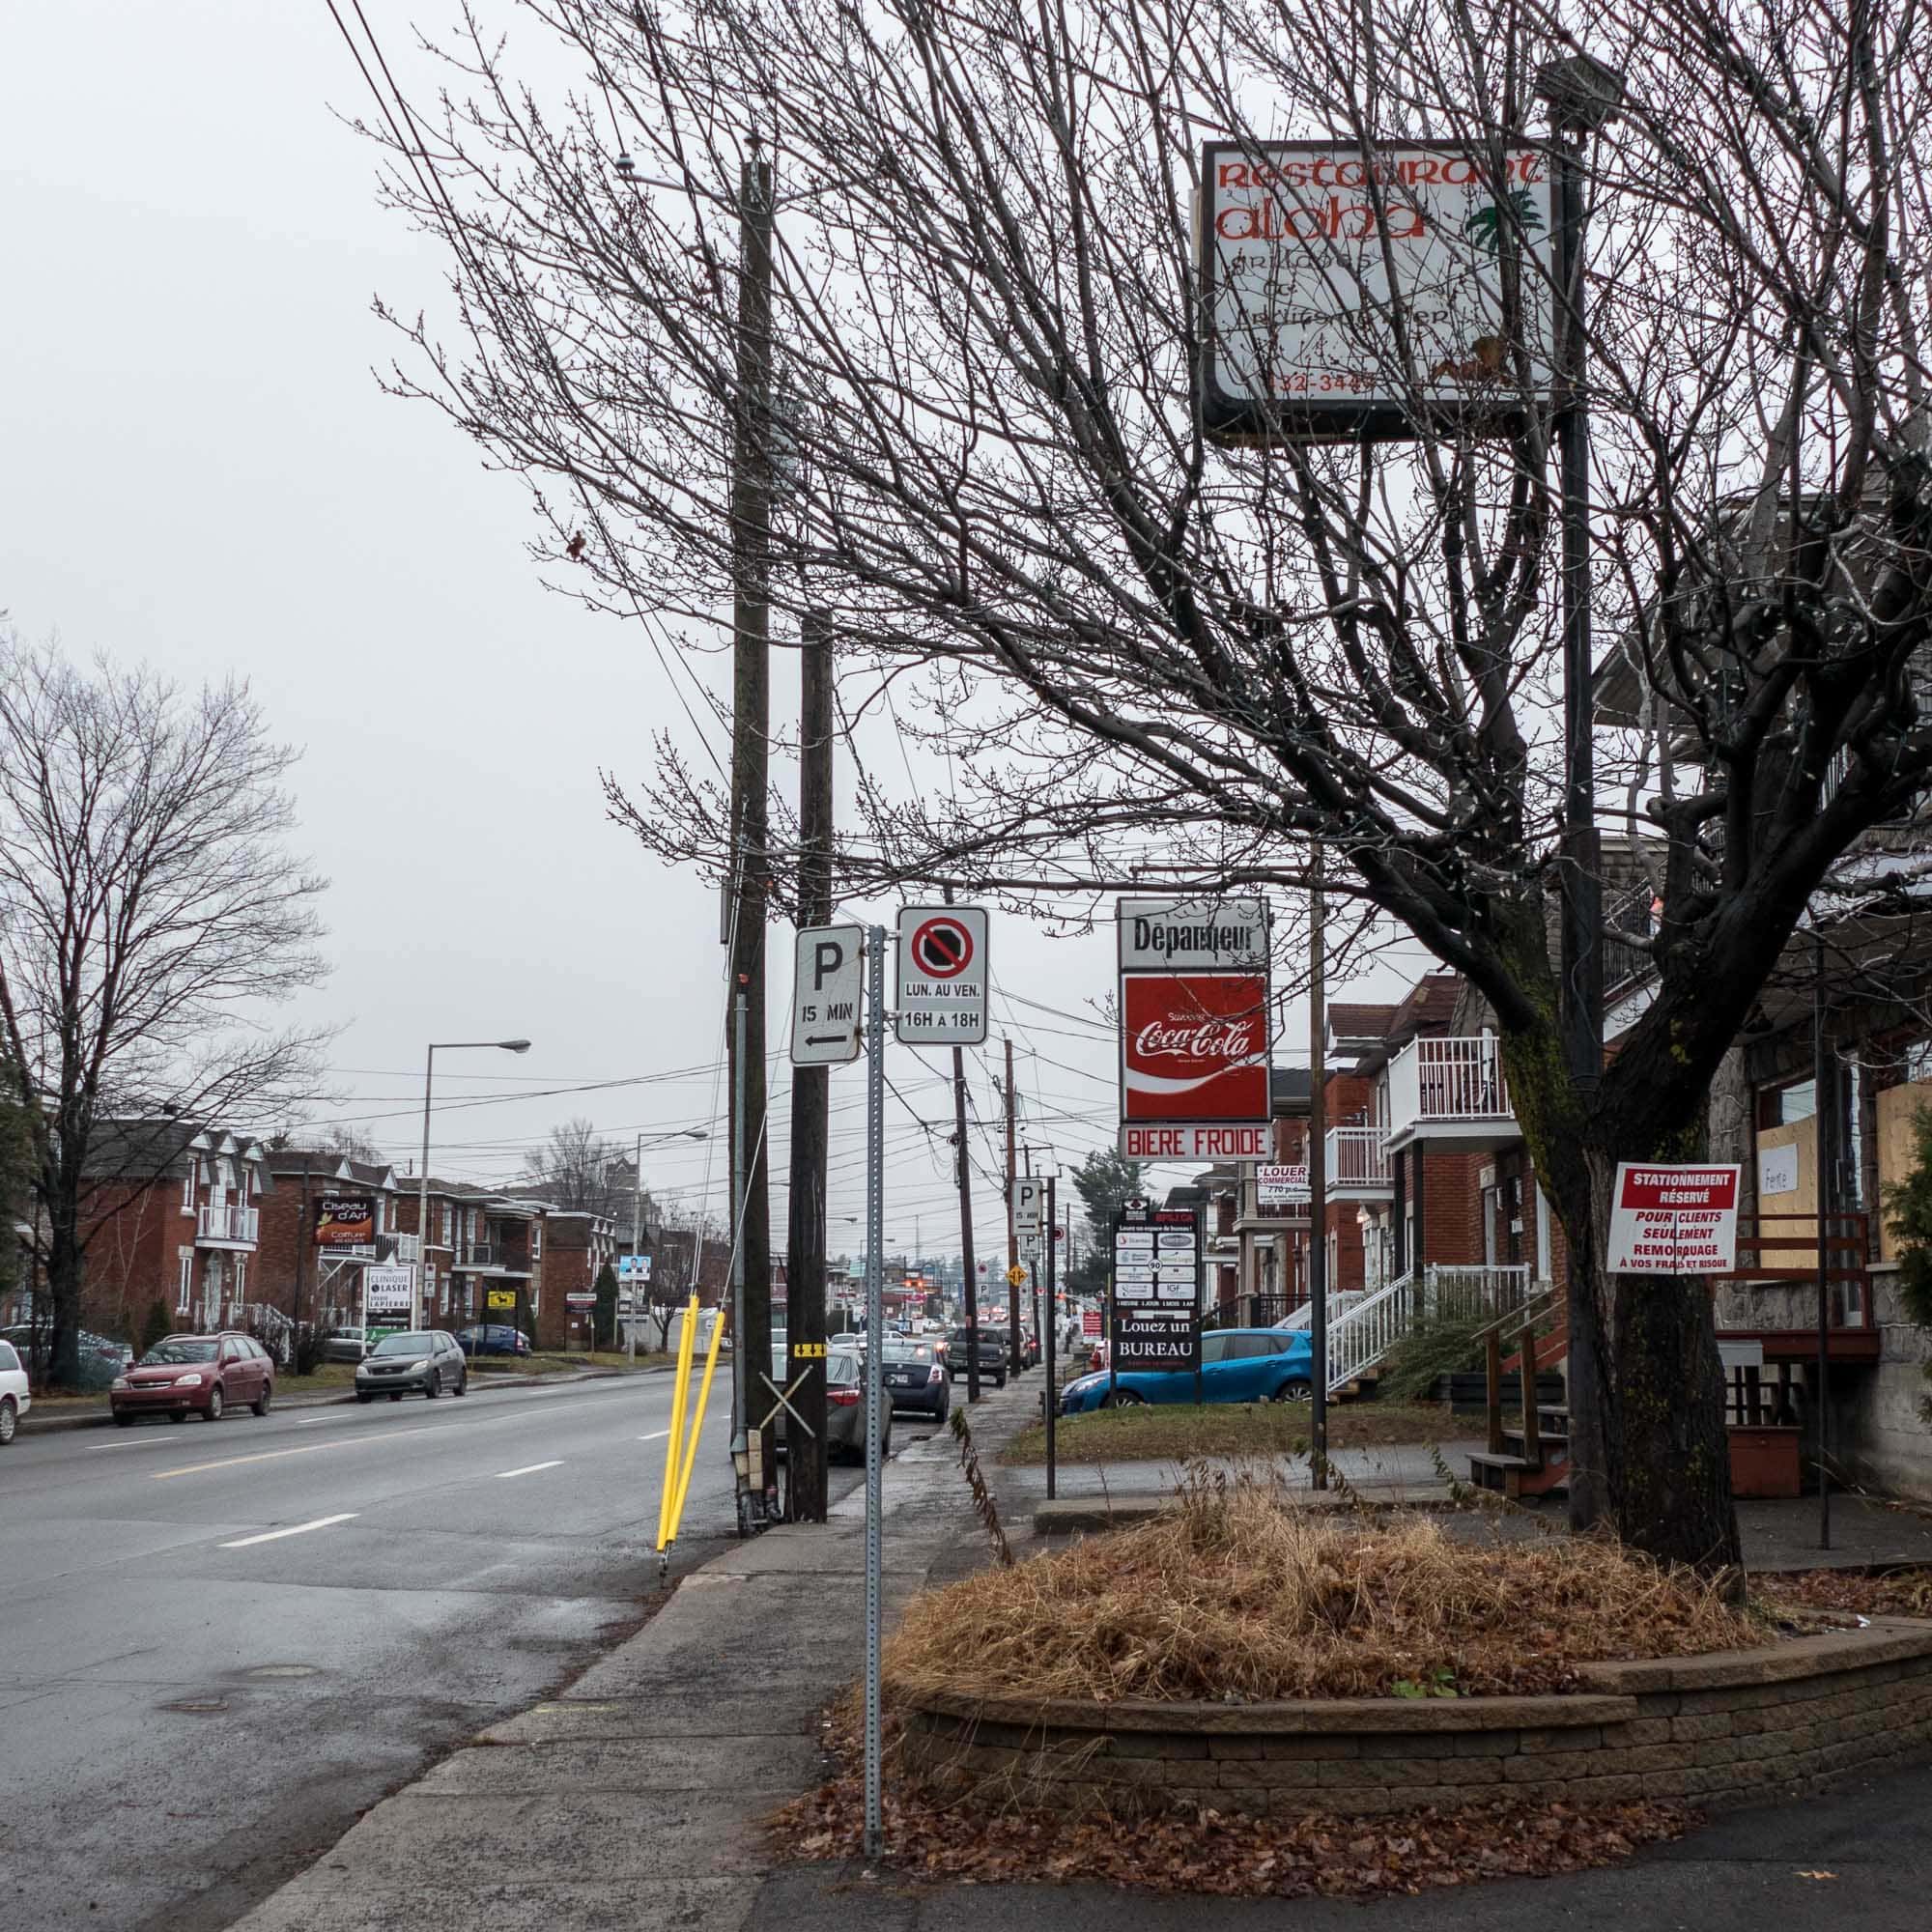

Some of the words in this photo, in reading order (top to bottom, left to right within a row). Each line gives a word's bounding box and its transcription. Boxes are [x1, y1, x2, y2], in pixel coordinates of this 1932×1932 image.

[1134, 918, 1254, 958] Dépanneur
[814, 942, 843, 990] P
[906, 983, 931, 996] LUN.
[935, 984, 951, 996] AU
[954, 984, 980, 997] VEN.
[803, 1006, 816, 1022] 15
[827, 1003, 852, 1020] MIN
[905, 1012, 932, 1026] 16H
[952, 1012, 979, 1027] 18H
[1127, 1130, 1185, 1155] BIERE
[1195, 1128, 1266, 1154] FROIDE
[1264, 1167, 1307, 1176] LOUER
[1634, 1173, 1730, 1186] STATIONNEMENT
[1021, 1186, 1033, 1206] P
[1660, 1188, 1710, 1204] RÉSERVÉ
[1635, 1211, 1672, 1222] POUR
[1678, 1211, 1722, 1222] CLIENTS
[1642, 1228, 1715, 1239] SEULEMENT
[1634, 1244, 1718, 1256] REMORQUAGE
[1631, 1260, 1652, 1268] VOS
[1687, 1260, 1696, 1268] ET
[1699, 1259, 1727, 1268] RISQUE
[1122, 1320, 1167, 1332] Louez
[1171, 1323, 1190, 1332] un
[1120, 1343, 1193, 1355] BUREAU
